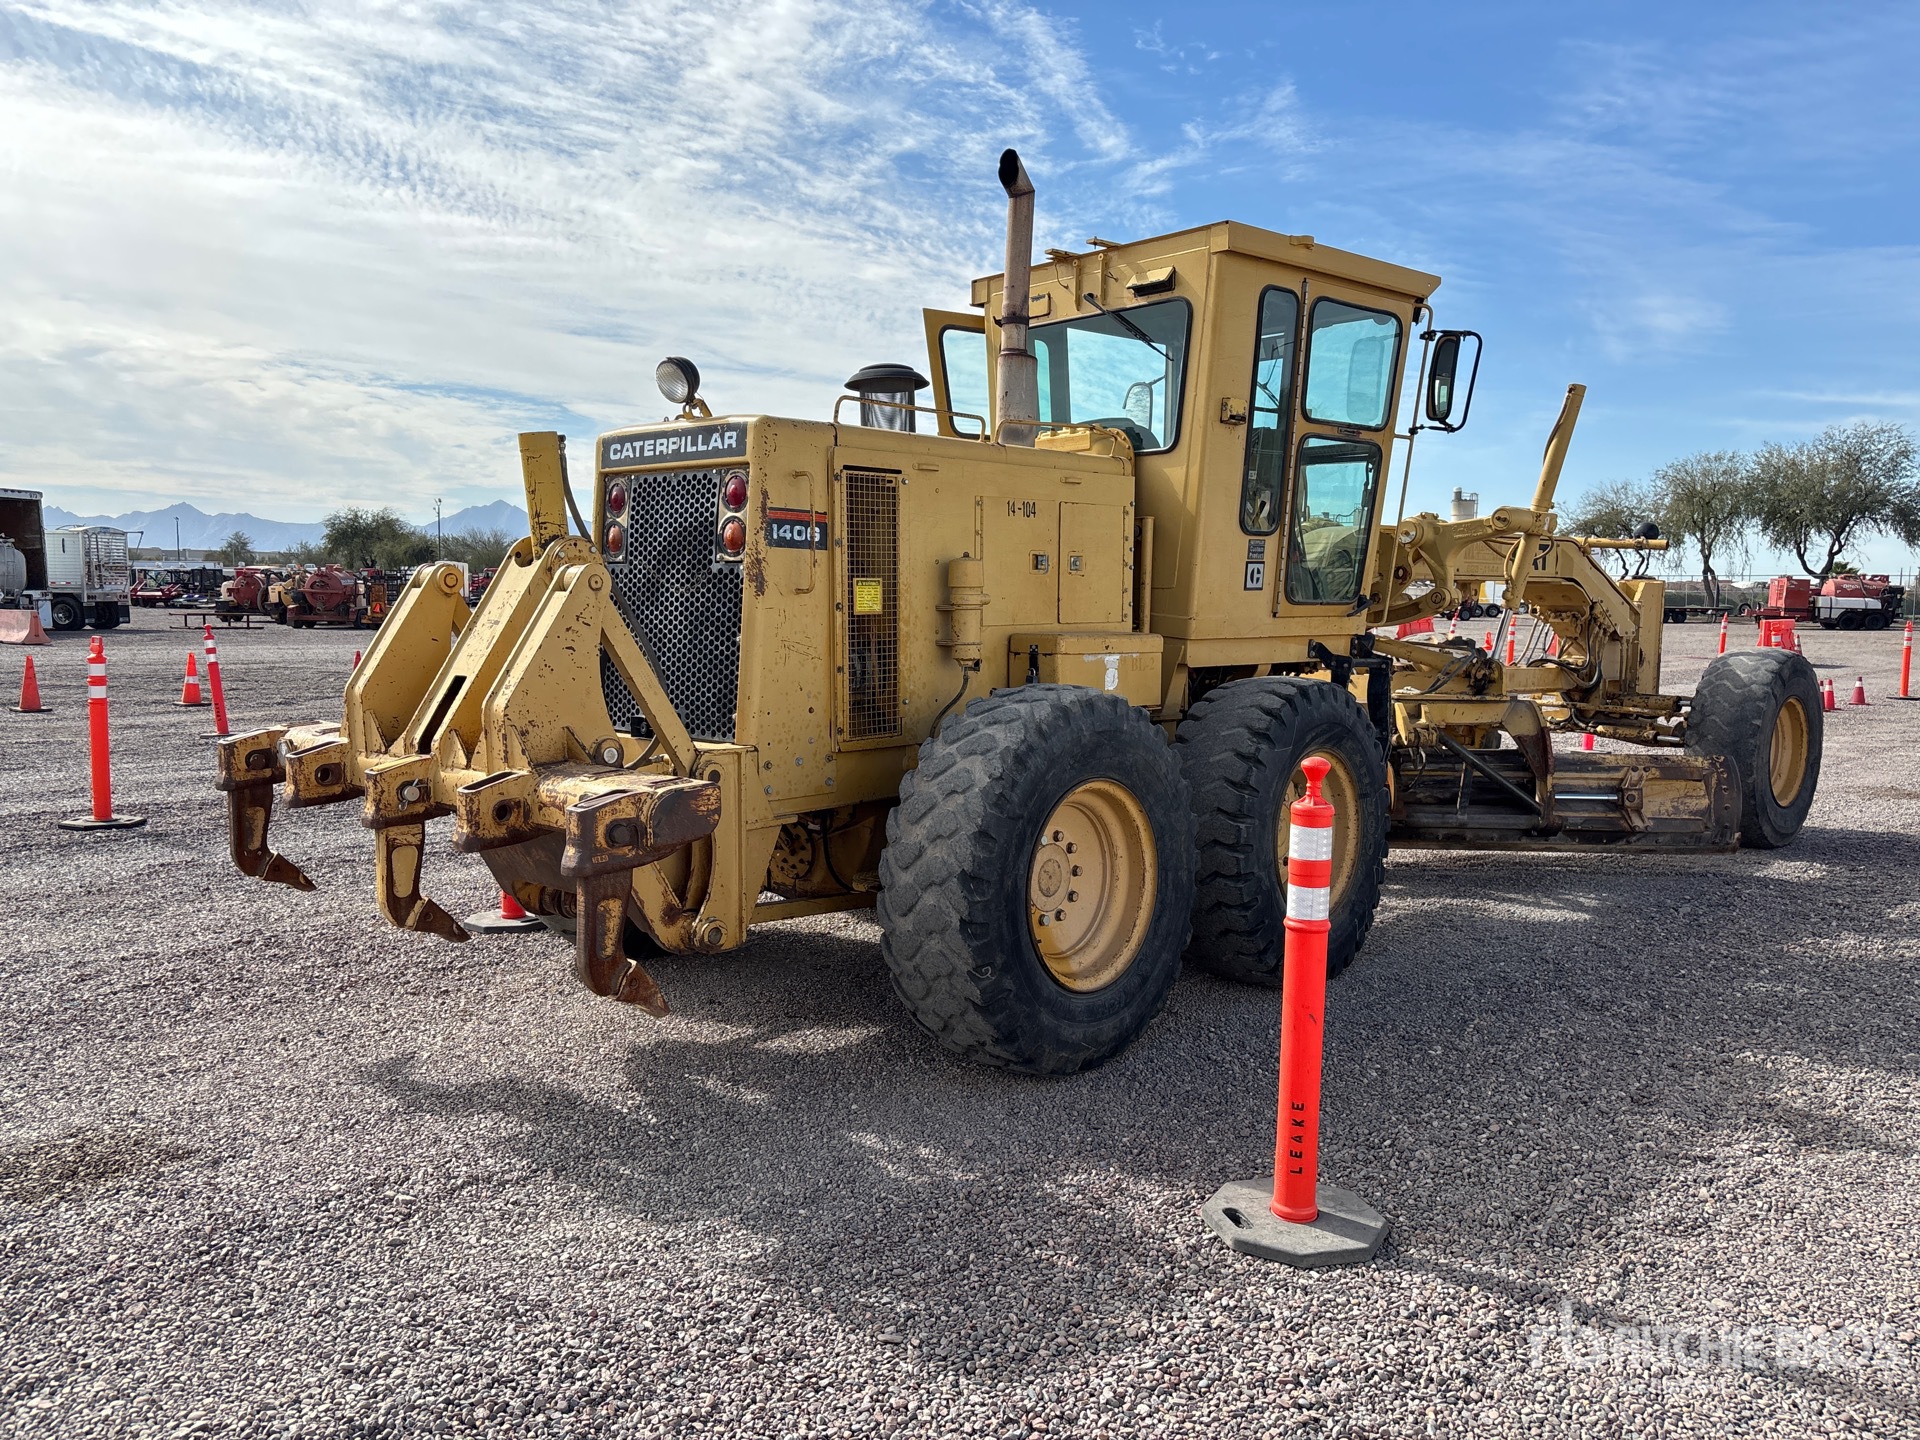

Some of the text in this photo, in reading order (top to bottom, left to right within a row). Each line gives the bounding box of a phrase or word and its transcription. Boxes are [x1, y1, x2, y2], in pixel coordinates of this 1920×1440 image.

[609, 431, 738, 461] CATERPILLAR
[1006, 500, 1037, 519] 14-104
[1289, 1101, 1305, 1175] LEAKE
